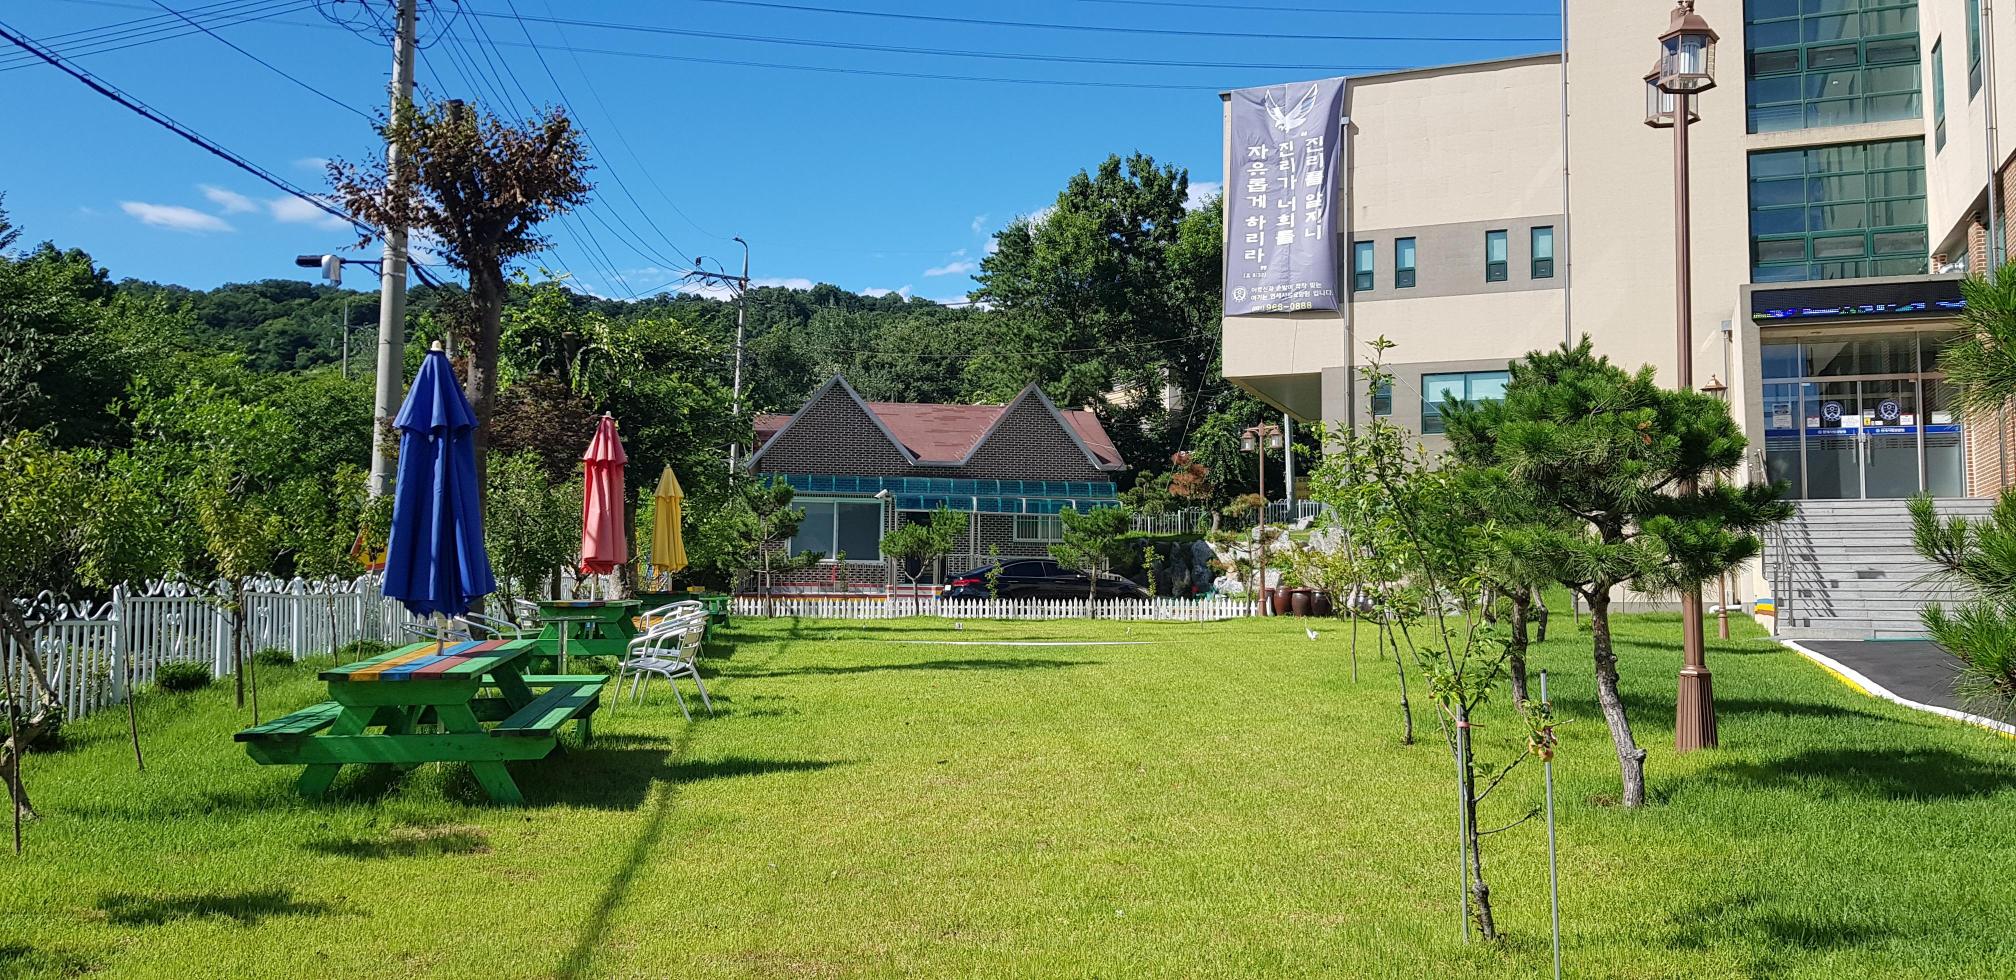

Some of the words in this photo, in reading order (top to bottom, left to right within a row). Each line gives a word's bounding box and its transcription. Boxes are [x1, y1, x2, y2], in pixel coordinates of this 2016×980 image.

[1246, 144, 1269, 209] 자유롭게
[1277, 140, 1297, 190] 진리가
[1275, 196, 1296, 246] 너희를
[1305, 190, 1323, 240] 알지니
